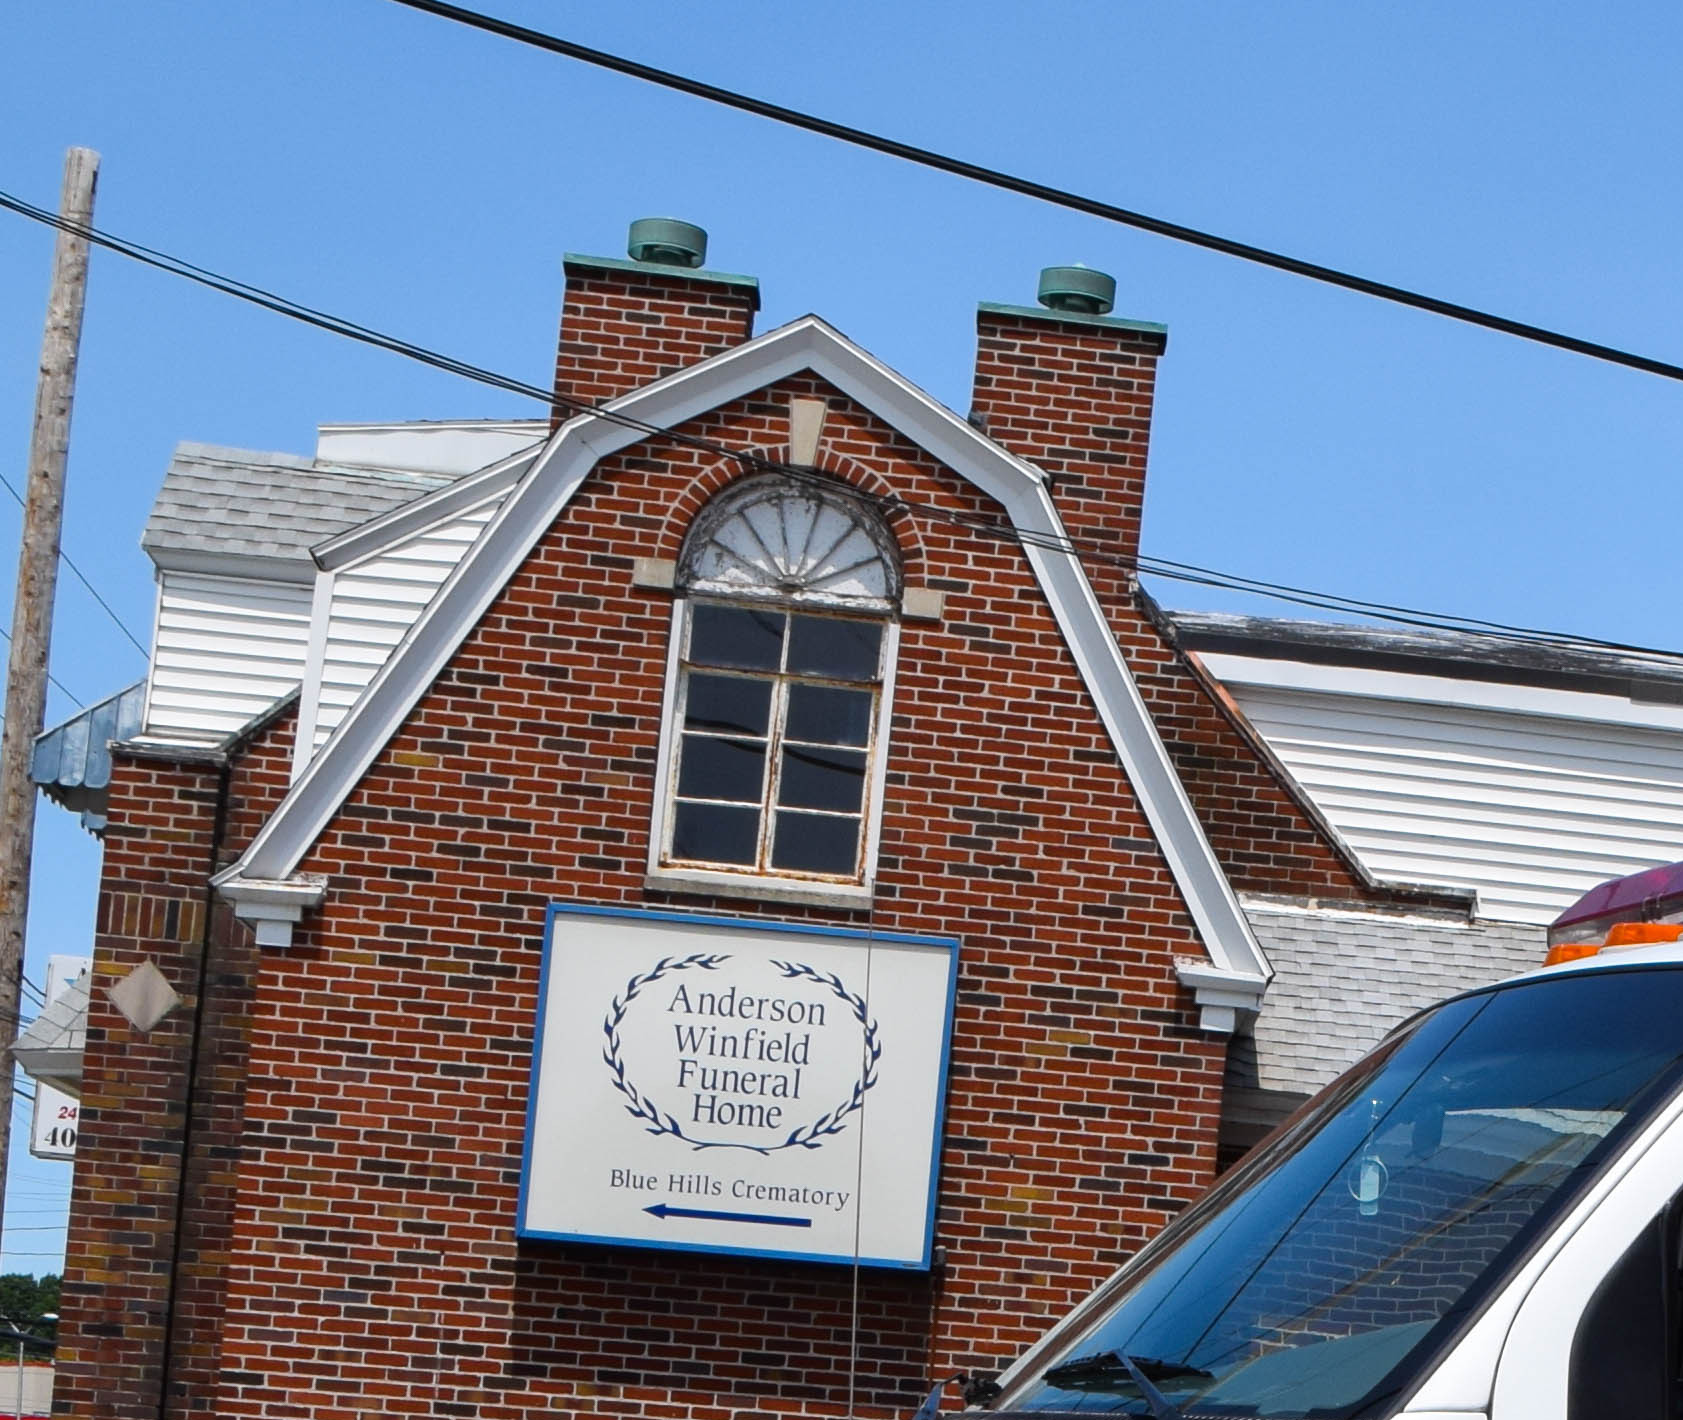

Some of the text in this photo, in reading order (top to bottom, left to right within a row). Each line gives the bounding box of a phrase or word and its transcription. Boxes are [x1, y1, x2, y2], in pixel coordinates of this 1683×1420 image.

[667, 984, 826, 1026] Anderson
[674, 1024, 810, 1065] Winfield
[677, 1059, 802, 1099] Funeral
[692, 1094, 783, 1129] Home
[609, 1169, 850, 1211] Blue Hills Crematory
